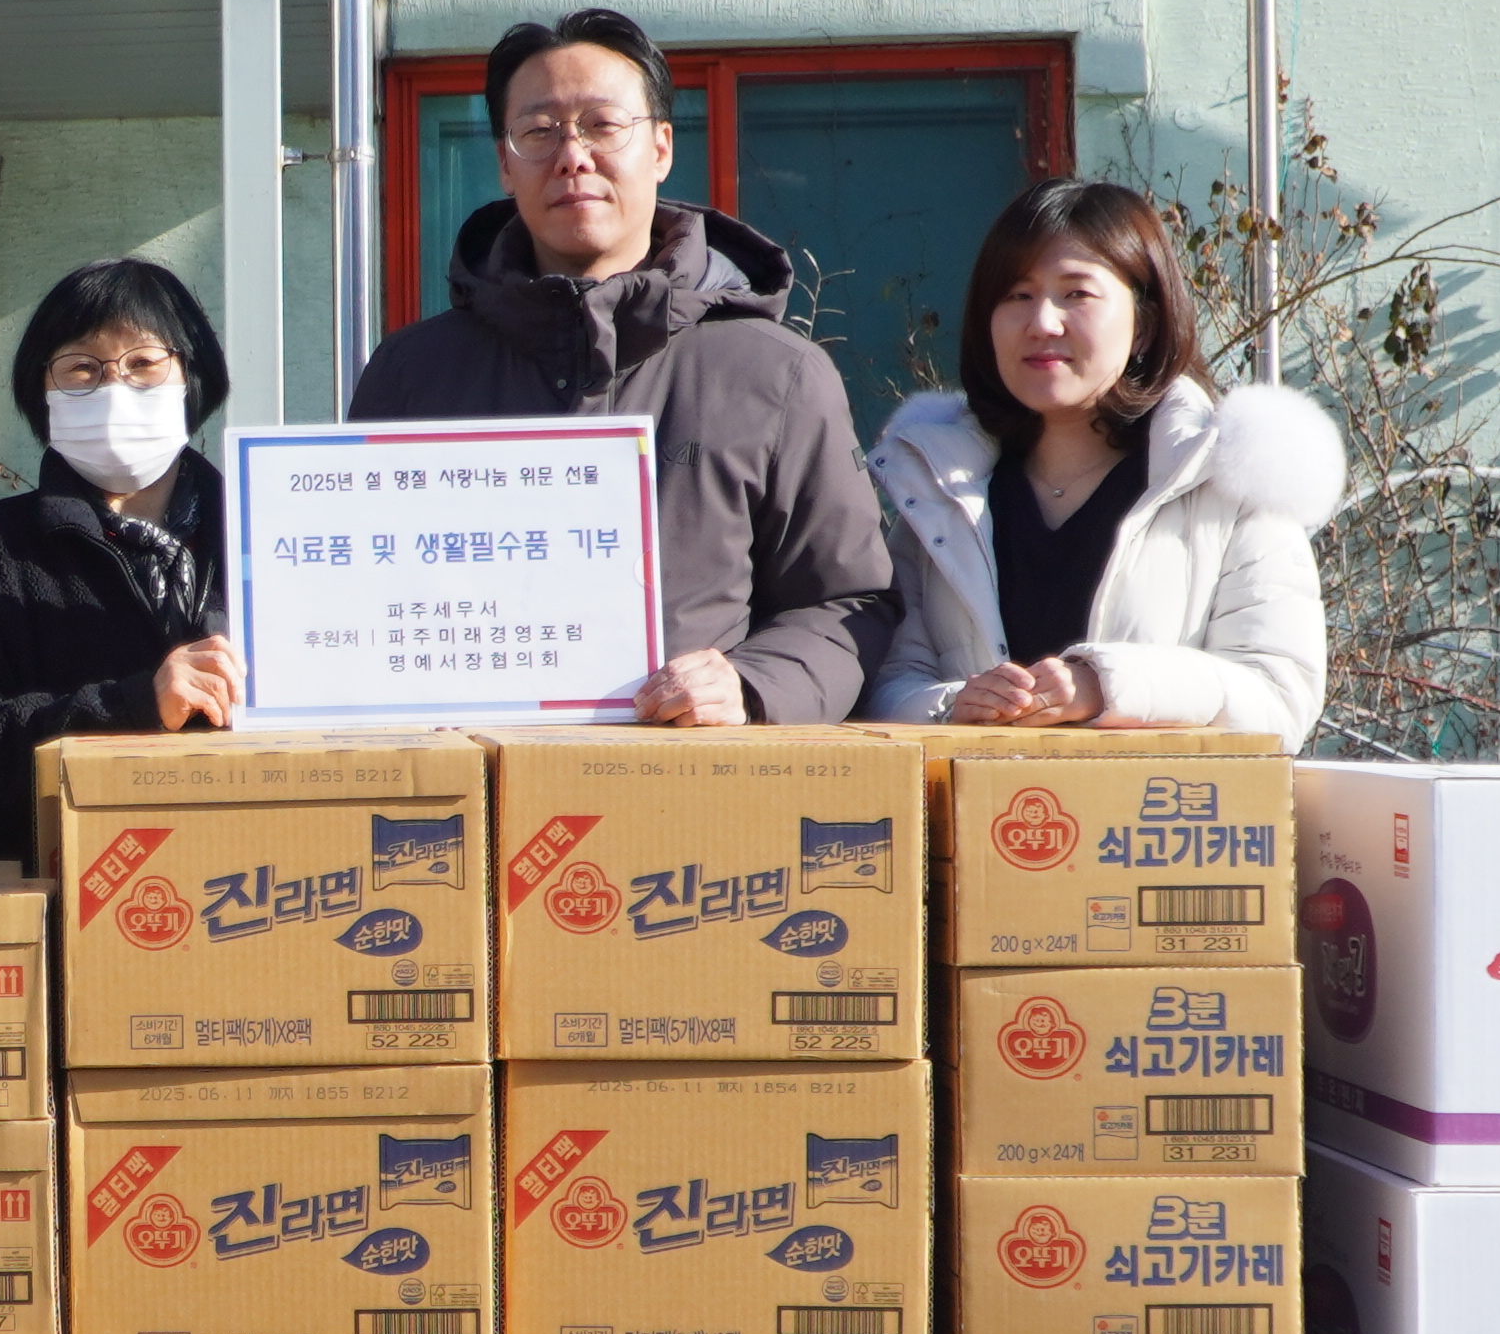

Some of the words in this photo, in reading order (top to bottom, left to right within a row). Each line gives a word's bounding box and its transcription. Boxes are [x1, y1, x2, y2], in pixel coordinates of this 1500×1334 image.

[291, 473, 354, 492] 2025년
[365, 471, 381, 491] 설
[394, 470, 427, 490] 명절
[439, 467, 508, 489] 사랑나눔
[520, 467, 554, 487] 위문
[565, 465, 599, 486] 선물
[274, 535, 353, 566] 식료품
[372, 534, 396, 564] 및
[415, 529, 550, 564] 생활필수품
[567, 528, 620, 560] 기부
[304, 630, 360, 648] 후원처
[132, 771, 247, 785] 2025.06.11
[262, 770, 287, 785] 까지
[299, 770, 344, 784] 1855
[355, 769, 402, 783] B212
[1139, 777, 1218, 822] 3분
[1008, 829, 1063, 850] 오뚜기
[1098, 825, 1275, 868] 쇠고기카레
[84, 834, 146, 900] 멀티팩
[200, 865, 364, 944] 진라면
[627, 864, 791, 943] 진라면
[130, 913, 179, 933] 오뚜기
[353, 918, 411, 950] 순한맛
[779, 919, 837, 952] 순한맛
[991, 935, 1018, 953] 200
[1161, 938, 1187, 951] 31
[1203, 937, 1243, 951] 231
[1147, 986, 1226, 1031] 3분
[136, 1019, 179, 1032] 소비기간
[144, 1033, 172, 1045] 6개월
[371, 1034, 399, 1047] 52
[408, 1034, 449, 1047] 225
[1105, 1034, 1283, 1077] 쇠고기카레
[207, 1183, 371, 1262] 진라면
[632, 1178, 796, 1257] 진라면
[1147, 1196, 1226, 1240] 3분
[137, 1230, 187, 1251] 오뚜기
[360, 1237, 418, 1269] 순한맛
[785, 1234, 842, 1267] 순한맛
[1105, 1244, 1284, 1287] 쇠고기카레
